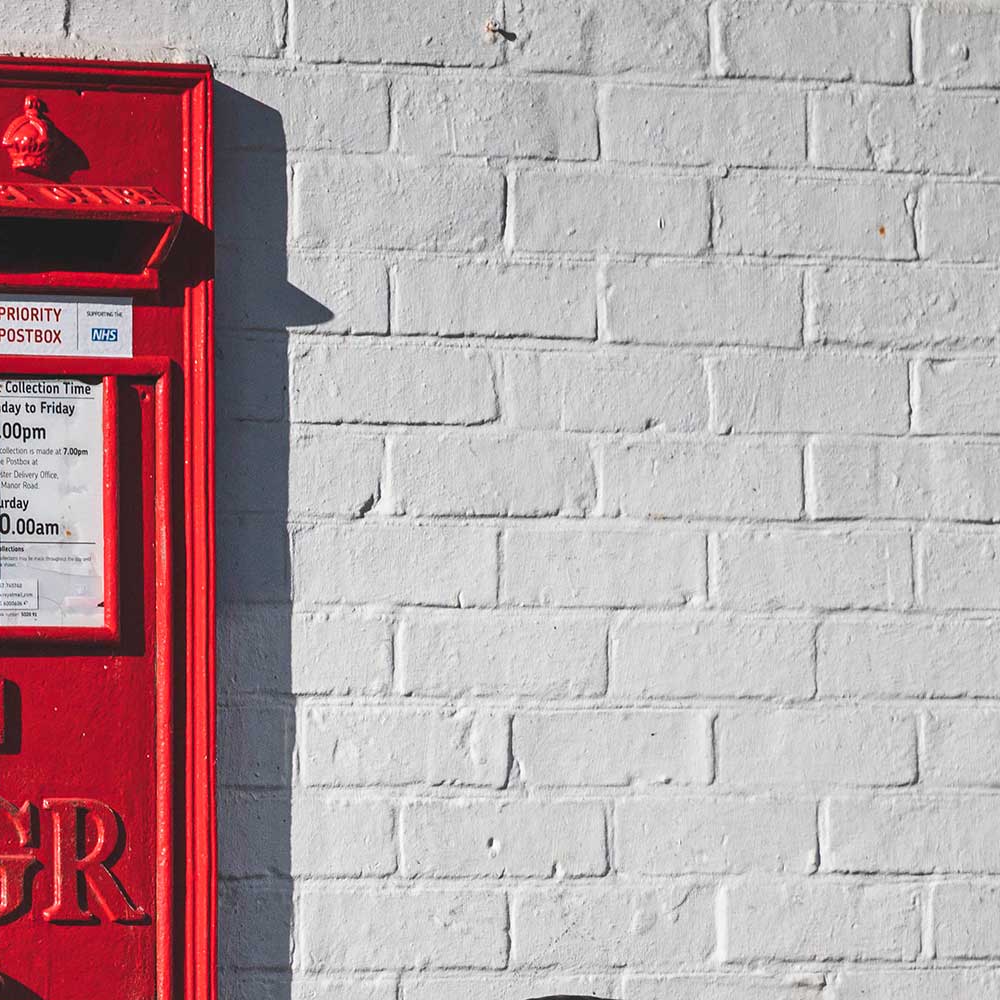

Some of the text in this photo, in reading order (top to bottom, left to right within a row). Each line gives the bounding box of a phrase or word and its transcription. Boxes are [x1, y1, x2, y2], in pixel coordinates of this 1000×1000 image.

[92, 329, 117, 341] NHS
[5, 381, 60, 395] Collection
[62, 382, 91, 395] Time
[25, 402, 36, 413] to
[40, 401, 75, 417] Friday
[0, 446, 28, 455] collection
[36, 447, 53, 455] made
[63, 447, 88, 457] 7.00pm
[6, 457, 30, 466] Postbox
[13, 471, 38, 480] Delivery
